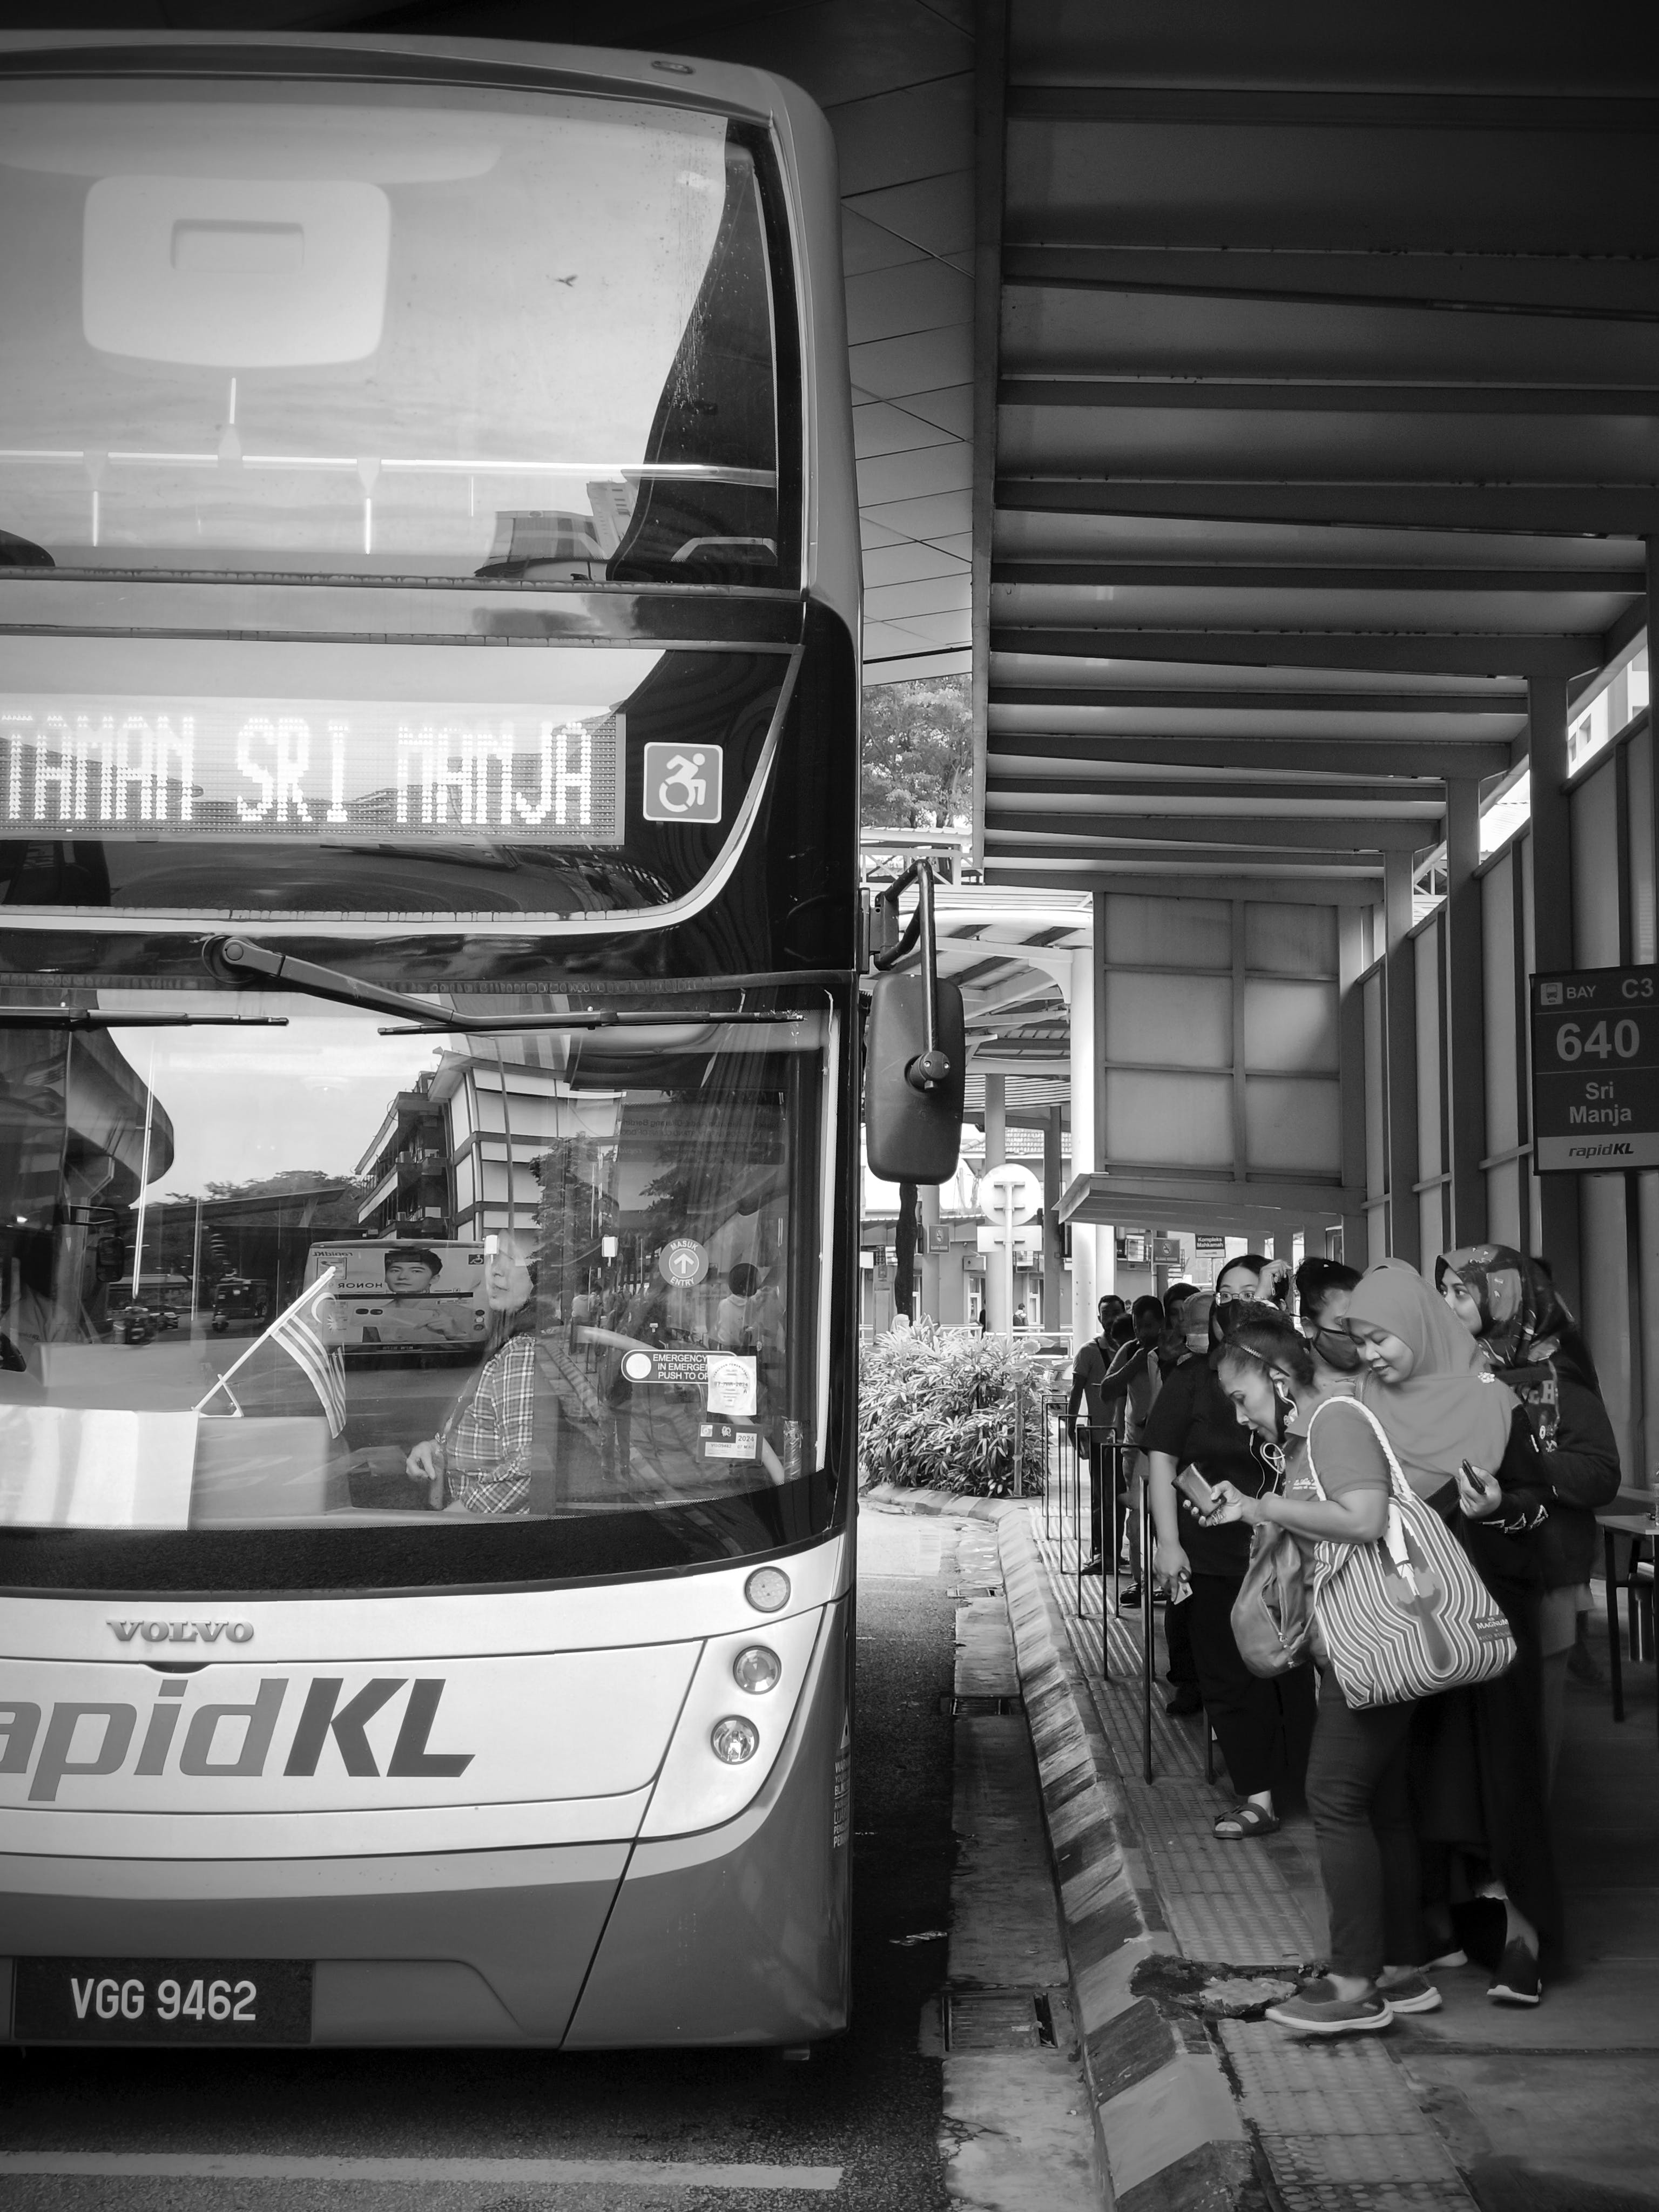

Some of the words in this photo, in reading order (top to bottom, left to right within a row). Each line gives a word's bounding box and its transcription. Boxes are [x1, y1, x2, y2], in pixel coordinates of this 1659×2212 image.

[1, 716, 194, 820] TAMAN
[237, 718, 348, 822] SRI
[396, 721, 592, 825] MANJA
[1567, 986, 1596, 999] BAY
[1622, 978, 1654, 999] C3
[1556, 1020, 1640, 1061] 640
[1586, 1081, 1614, 1100] Sri
[1569, 1104, 1632, 1126] Manja
[1569, 1143, 1634, 1158] rapidKL
[670, 1240, 698, 1251] MASUK
[670, 1276, 694, 1286] ENTRY
[653, 1353, 707, 1362] EMERGENCY
[658, 1363, 666, 1371] IN
[658, 1371, 682, 1380] PUSH
[106, 1620, 254, 1642] VOLVO
[1476, 1618, 1509, 1630] MAGNUM
[71, 1978, 145, 2019] VGG
[157, 1979, 257, 2020] 9462
